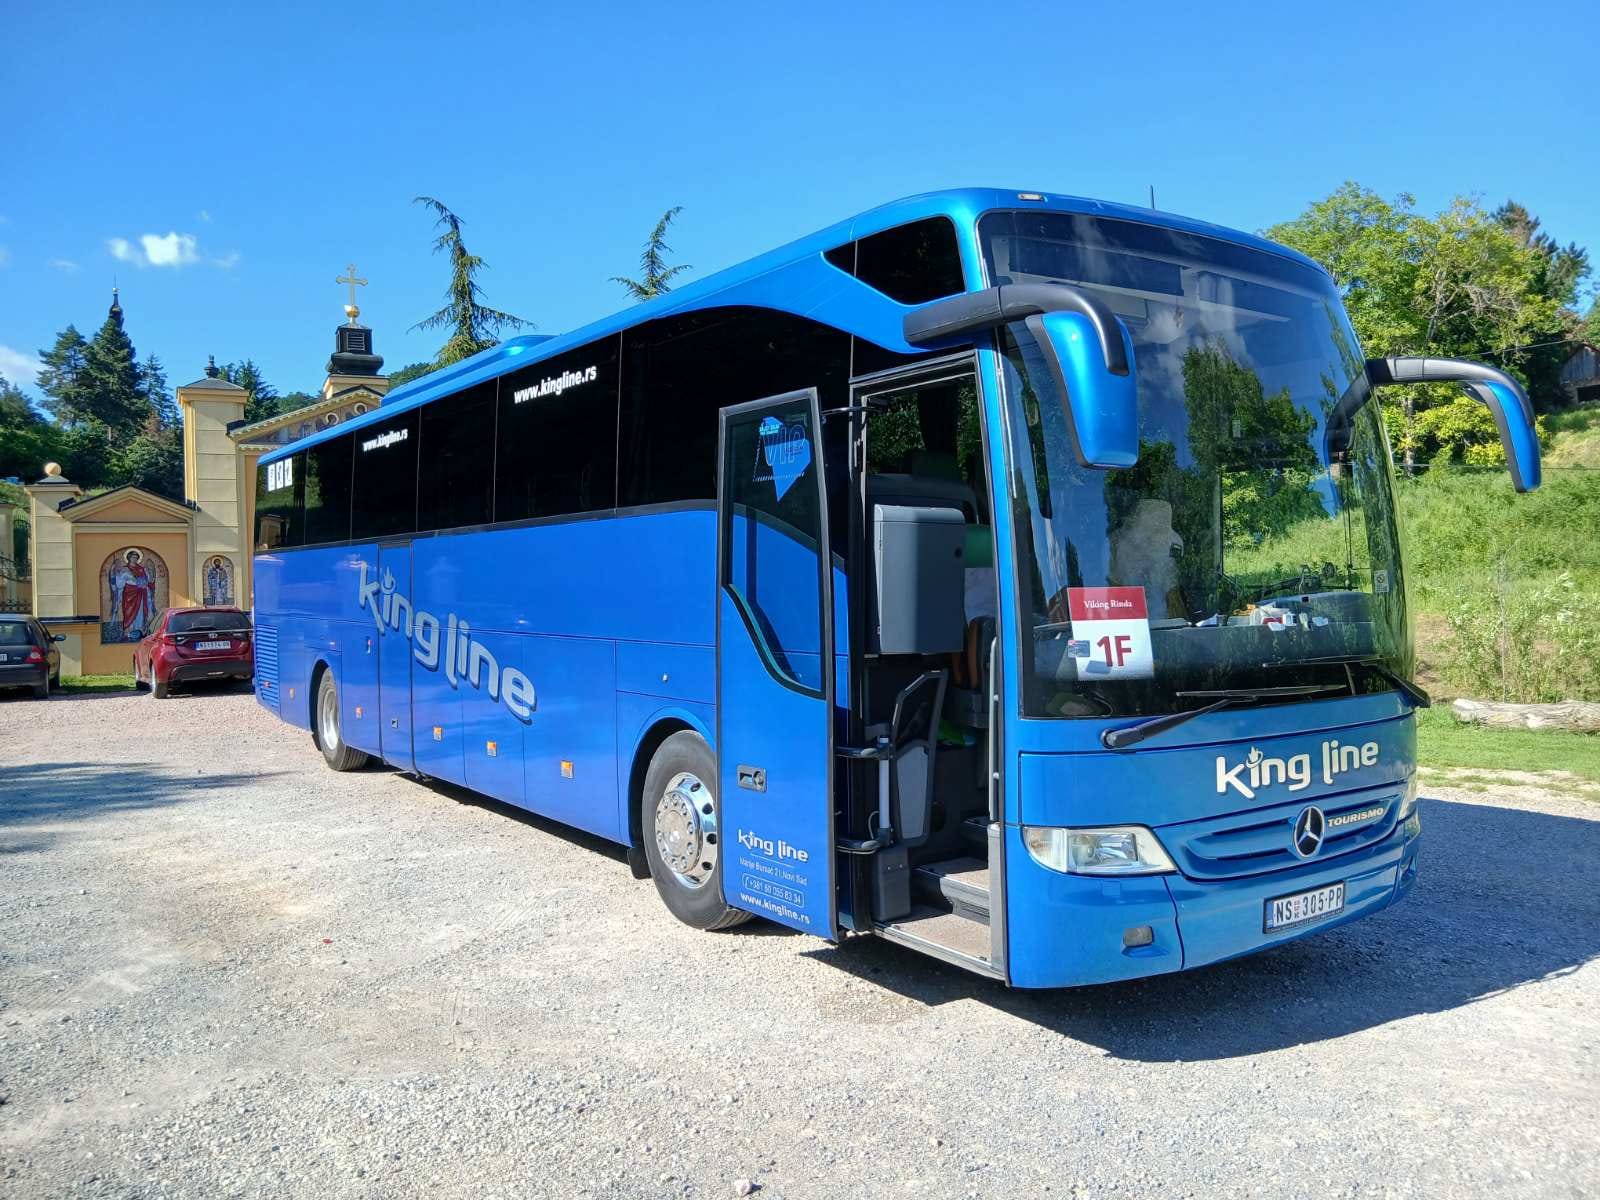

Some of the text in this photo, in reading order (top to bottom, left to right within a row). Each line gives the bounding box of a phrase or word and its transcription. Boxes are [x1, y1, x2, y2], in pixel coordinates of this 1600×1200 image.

[514, 365, 597, 404] www.kingline.rs
[363, 428, 408, 451] www.kingline.rs
[1083, 599, 1109, 610] Viking
[359, 561, 537, 725] king line
[1097, 635, 1132, 667] 1F
[1216, 739, 1379, 799] king line
[1327, 807, 1384, 827] TOURISMO
[738, 829, 809, 862] king line
[740, 892, 810, 925] www.kingline.rs
[1276, 900, 1292, 923] NS
